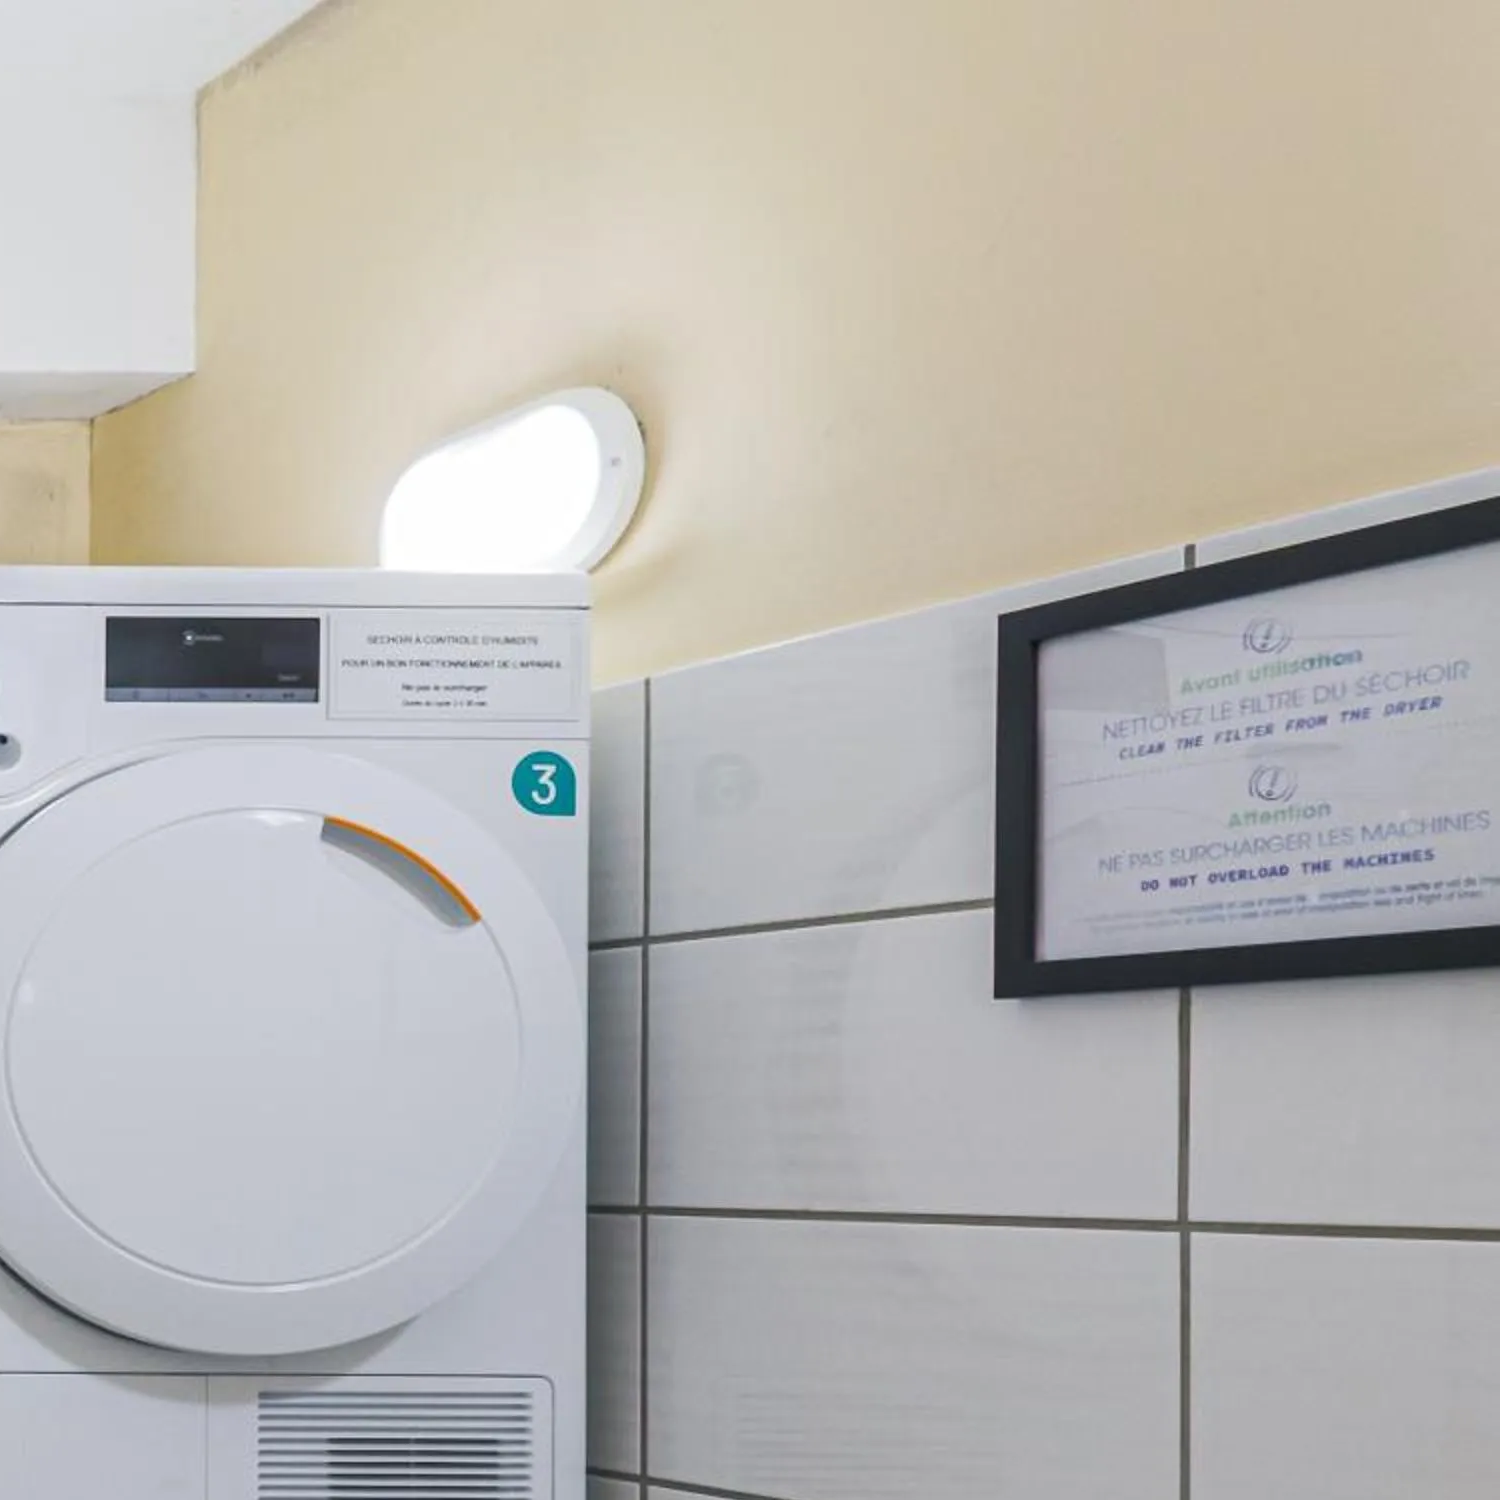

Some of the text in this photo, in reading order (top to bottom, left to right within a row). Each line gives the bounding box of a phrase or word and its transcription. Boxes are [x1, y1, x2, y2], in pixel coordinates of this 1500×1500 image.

[1181, 649, 1363, 695] Avant utilisation
[1102, 708, 1203, 742] NETTOYEZ
[1210, 702, 1232, 723] LE
[1239, 690, 1308, 717] FILTRE
[1314, 682, 1346, 705] DU
[1119, 695, 1443, 760] CLEAN THE FILTER FROM THE DRYER
[531, 764, 557, 805] 3
[1228, 802, 1332, 828] Attention
[1098, 810, 1491, 875] NE PAS SURCHARGER LES MACHINES
[1141, 849, 1435, 891] DO NOT OVERLOAD THE MACHINES
